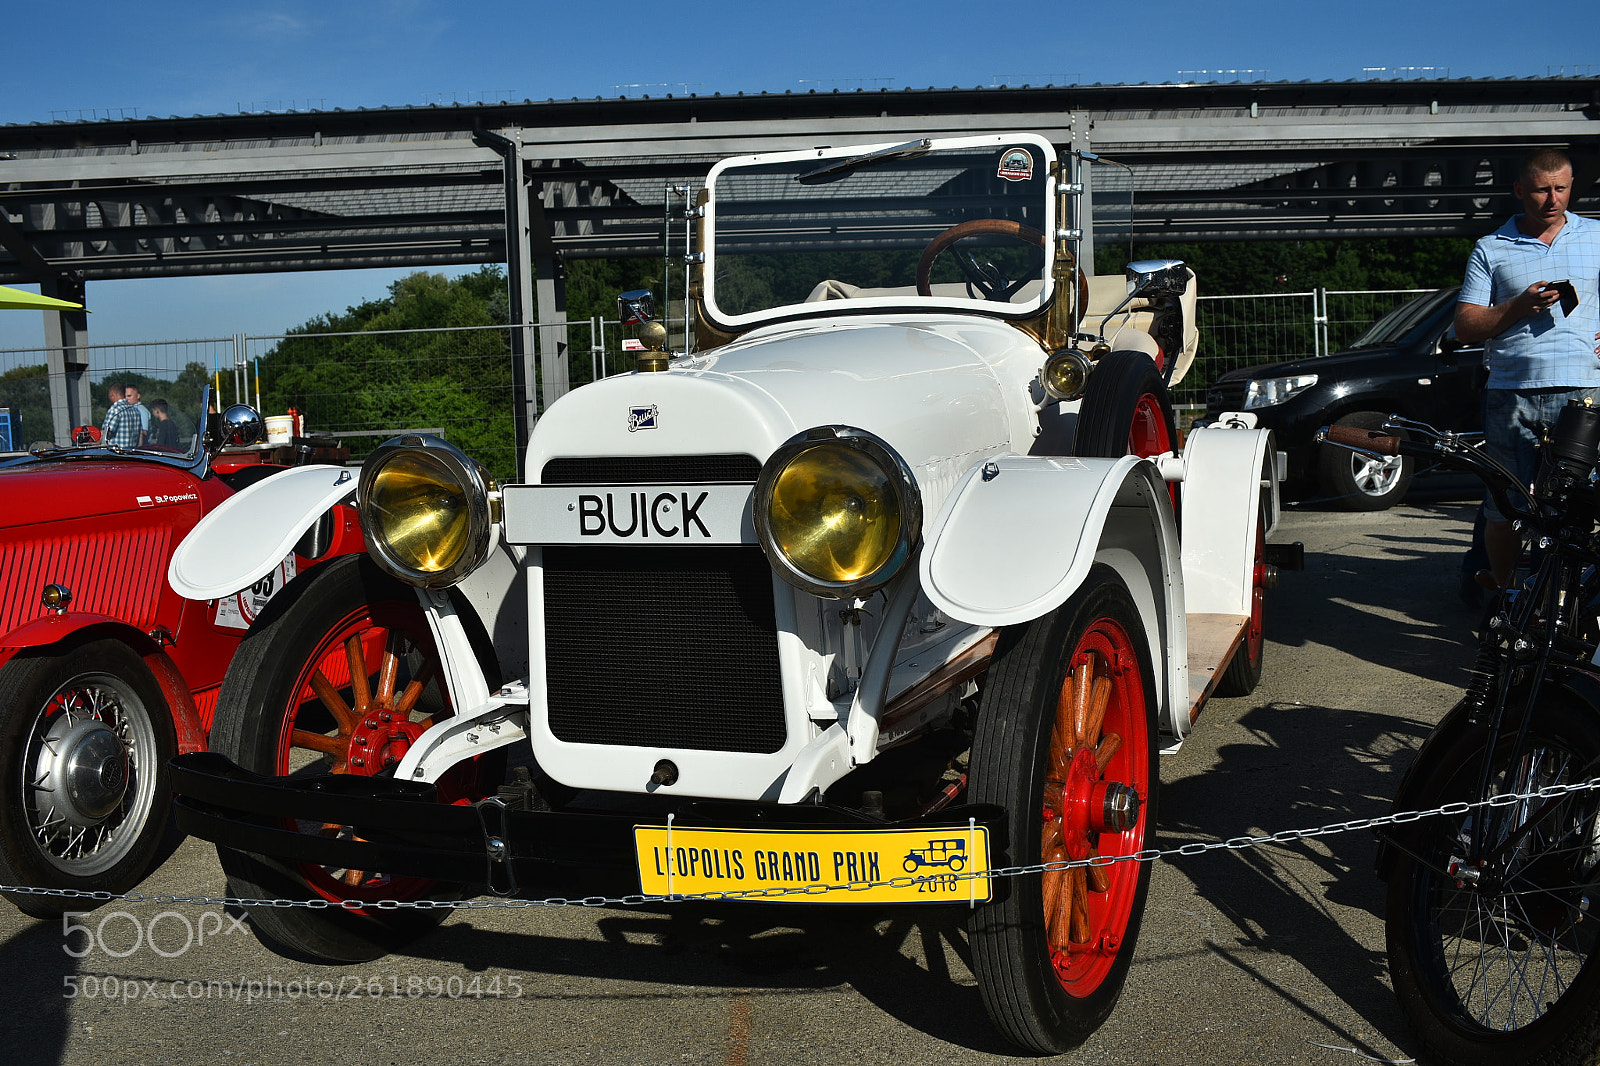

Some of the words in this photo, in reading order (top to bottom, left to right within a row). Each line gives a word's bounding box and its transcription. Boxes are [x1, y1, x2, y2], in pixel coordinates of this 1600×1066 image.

[628, 404, 659, 433] Buick
[578, 491, 712, 538] BUICK
[654, 846, 745, 880] LEOPOLIS
[755, 850, 820, 882] GRAND
[834, 850, 881, 882] PRIX
[917, 875, 958, 893] 2018
